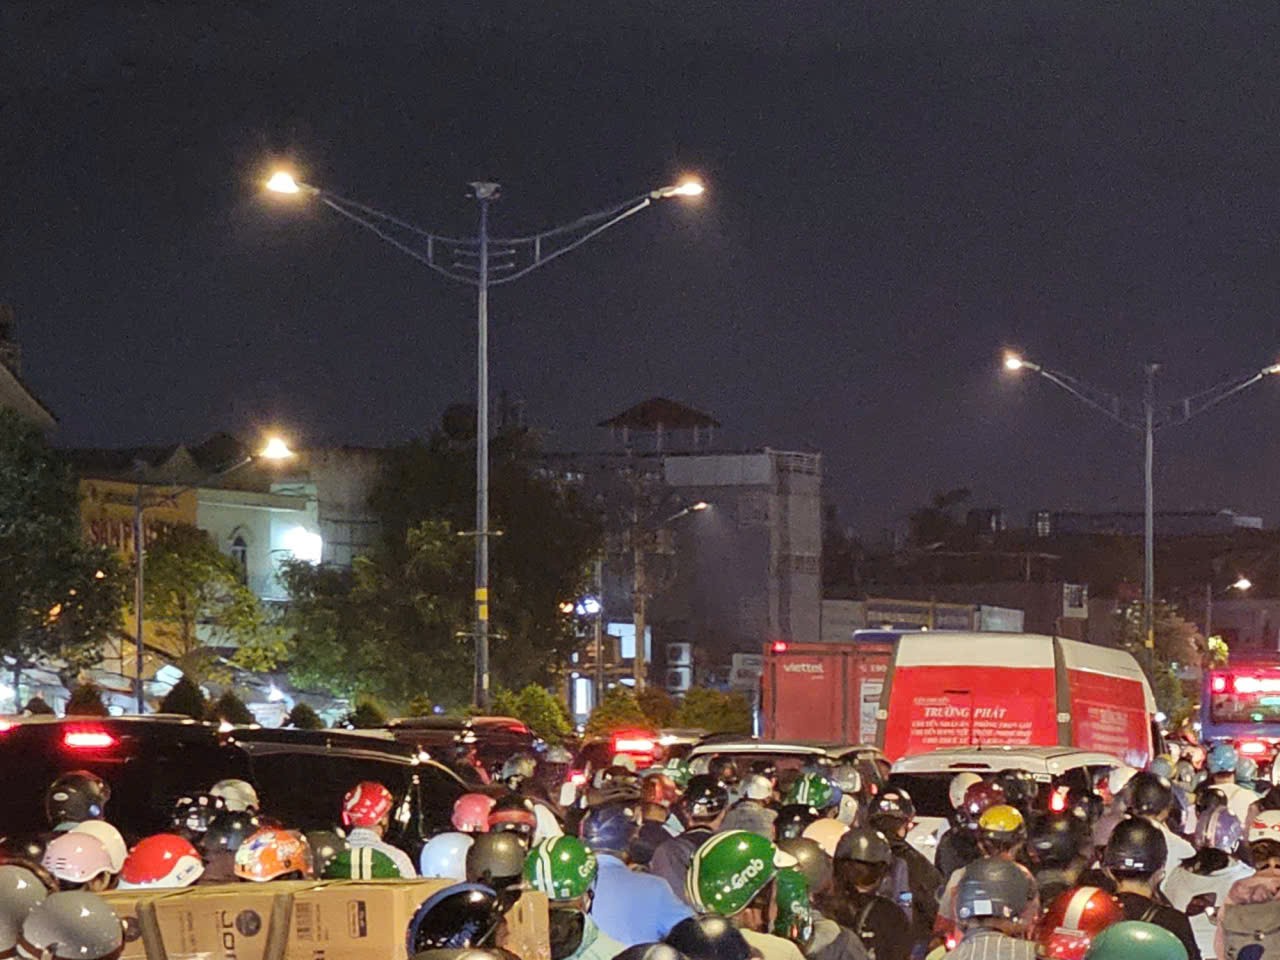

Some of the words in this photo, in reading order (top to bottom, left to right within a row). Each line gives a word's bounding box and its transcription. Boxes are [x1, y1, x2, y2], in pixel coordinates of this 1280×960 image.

[924, 705, 970, 718] TRƯỜNG
[973, 704, 1007, 719] PHÁT
[730, 857, 765, 890] Grab
